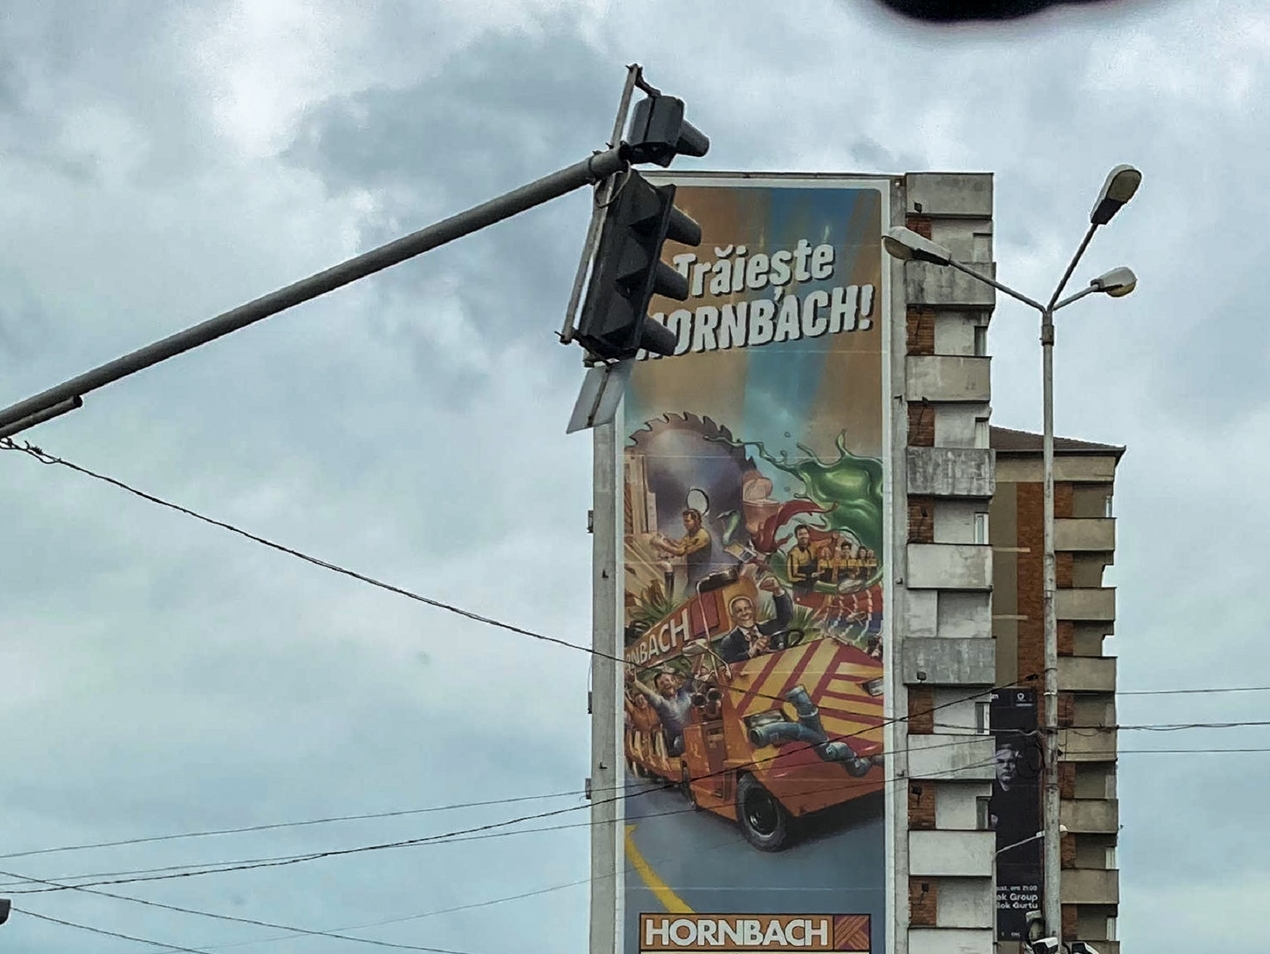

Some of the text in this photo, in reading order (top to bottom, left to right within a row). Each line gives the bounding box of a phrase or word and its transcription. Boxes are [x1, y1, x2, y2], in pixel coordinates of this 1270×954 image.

[635, 284, 875, 361] ORNBACH!
[1009, 892, 1038, 902] Group
[645, 918, 828, 947] HORNBACH
